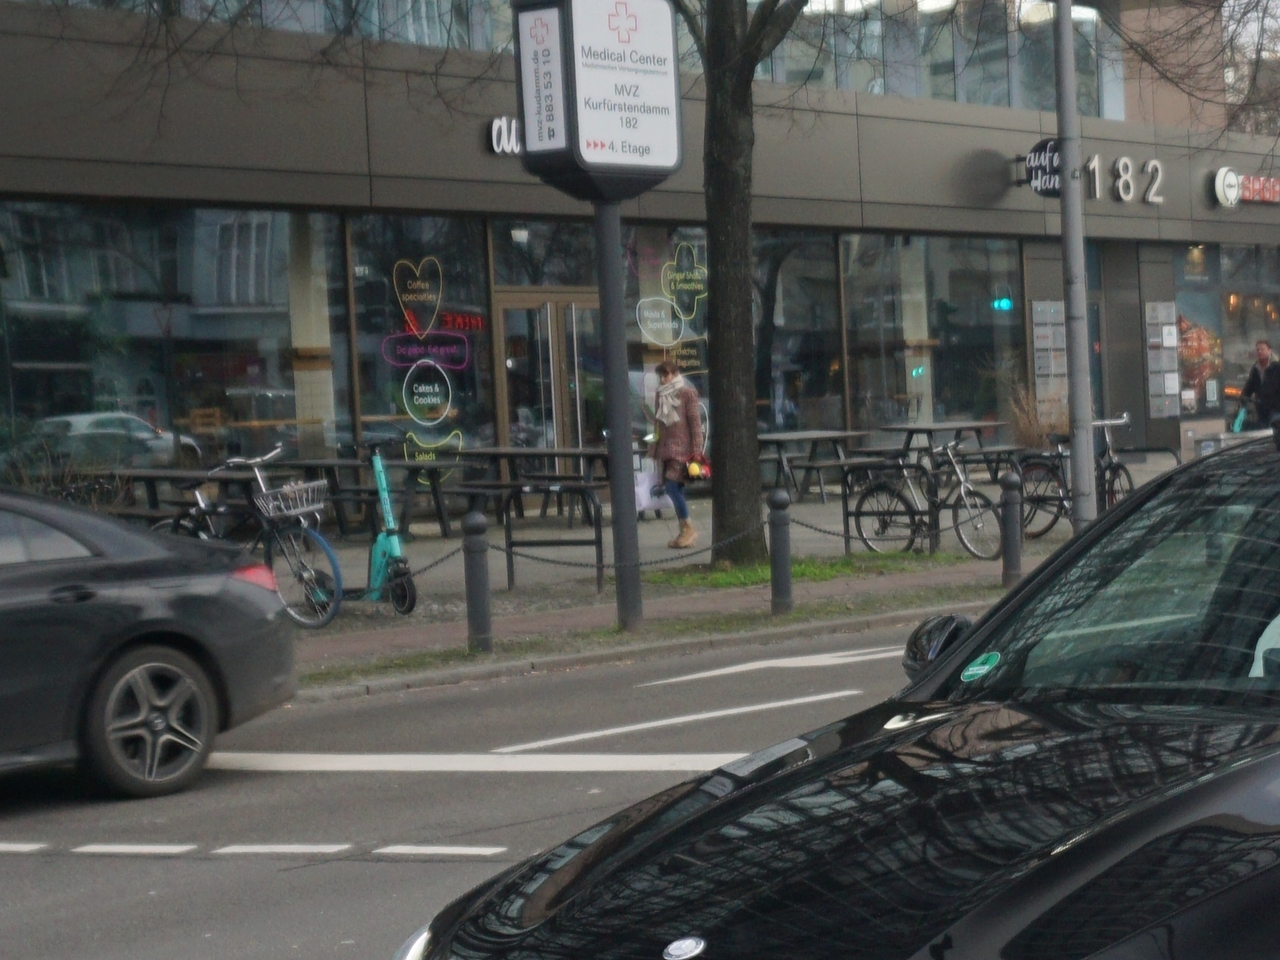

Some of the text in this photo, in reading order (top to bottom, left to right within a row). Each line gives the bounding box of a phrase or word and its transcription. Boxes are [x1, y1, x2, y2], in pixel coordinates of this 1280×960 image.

[581, 45, 668, 66] Medical Center
[542, 48, 555, 122] 883 53 10
[614, 83, 640, 97] MVZ
[532, 50, 544, 142] mvz-kudamm.de
[584, 97, 670, 116] Kurfürstendamm
[620, 116, 638, 129] 182
[492, 116, 520, 154] au
[608, 140, 651, 157] 4. Etage
[1030, 169, 1060, 192] Han
[1088, 154, 1163, 203] 182
[407, 281, 430, 290] Coffee
[413, 384, 433, 393] Cakes
[413, 395, 441, 404] Cookies
[415, 451, 436, 461] Salads
